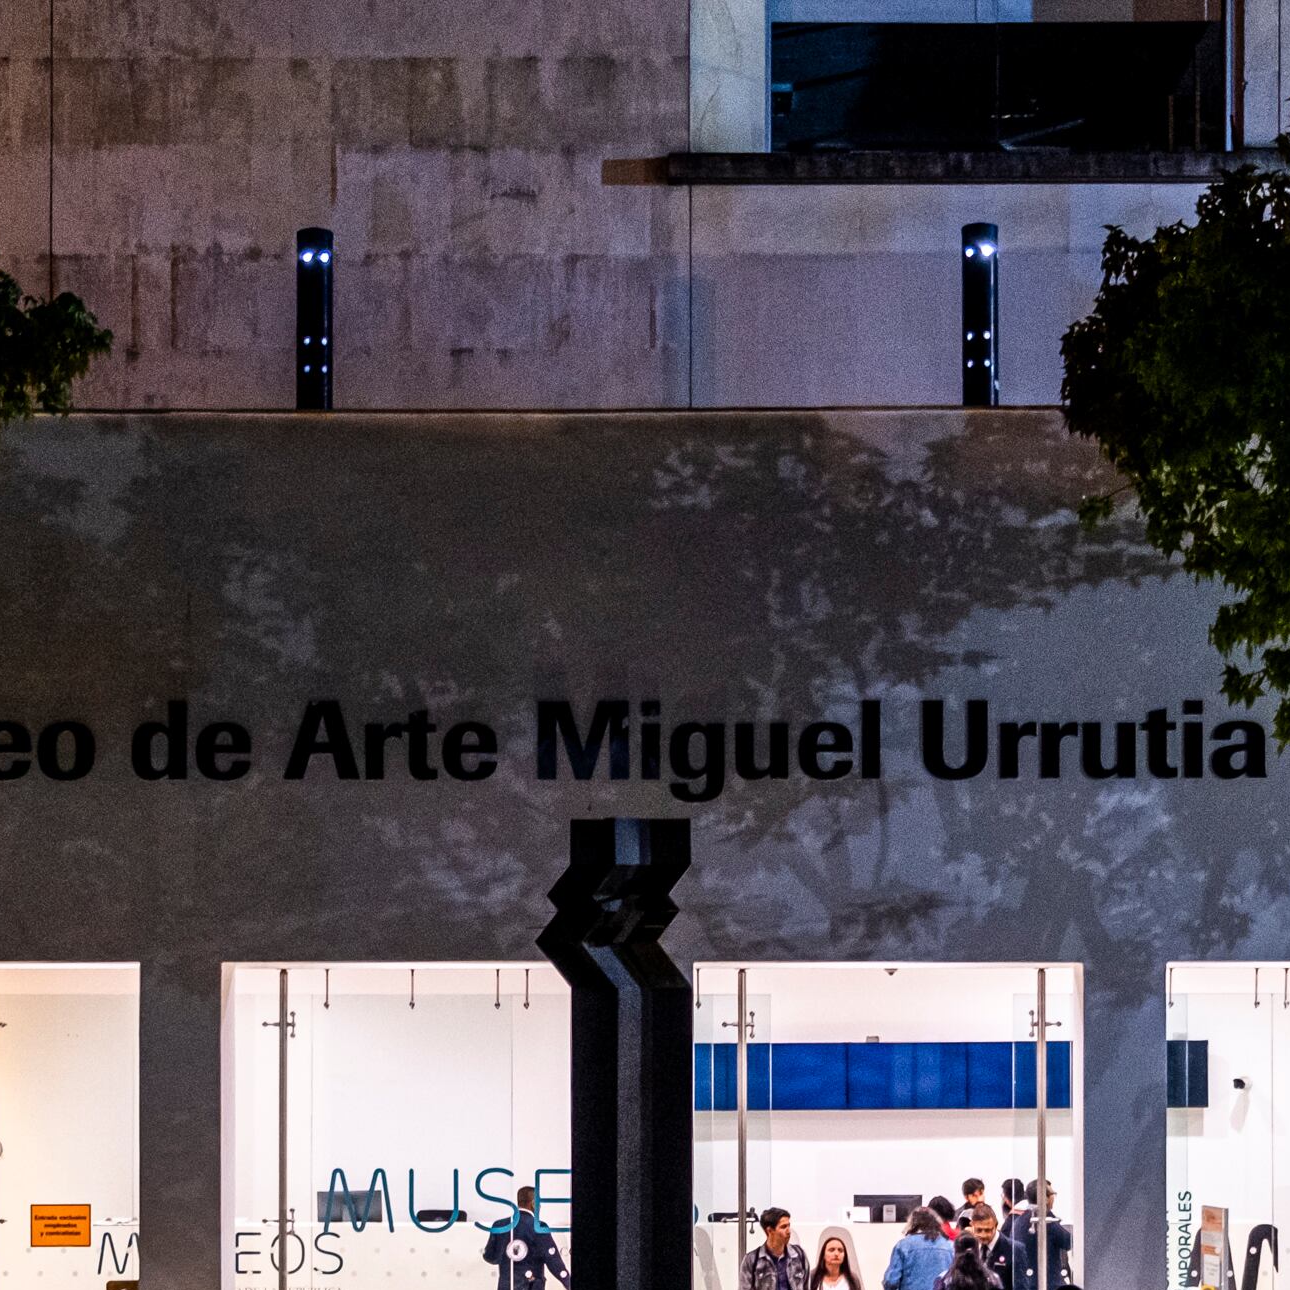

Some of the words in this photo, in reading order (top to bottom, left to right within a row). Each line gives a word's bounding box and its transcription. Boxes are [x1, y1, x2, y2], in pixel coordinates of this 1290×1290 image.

[131, 698, 252, 781] de
[284, 699, 499, 781] Arte
[536, 699, 882, 801] Miguel
[921, 699, 1267, 780] Urrutia
[324, 1168, 571, 1234] MUSE
